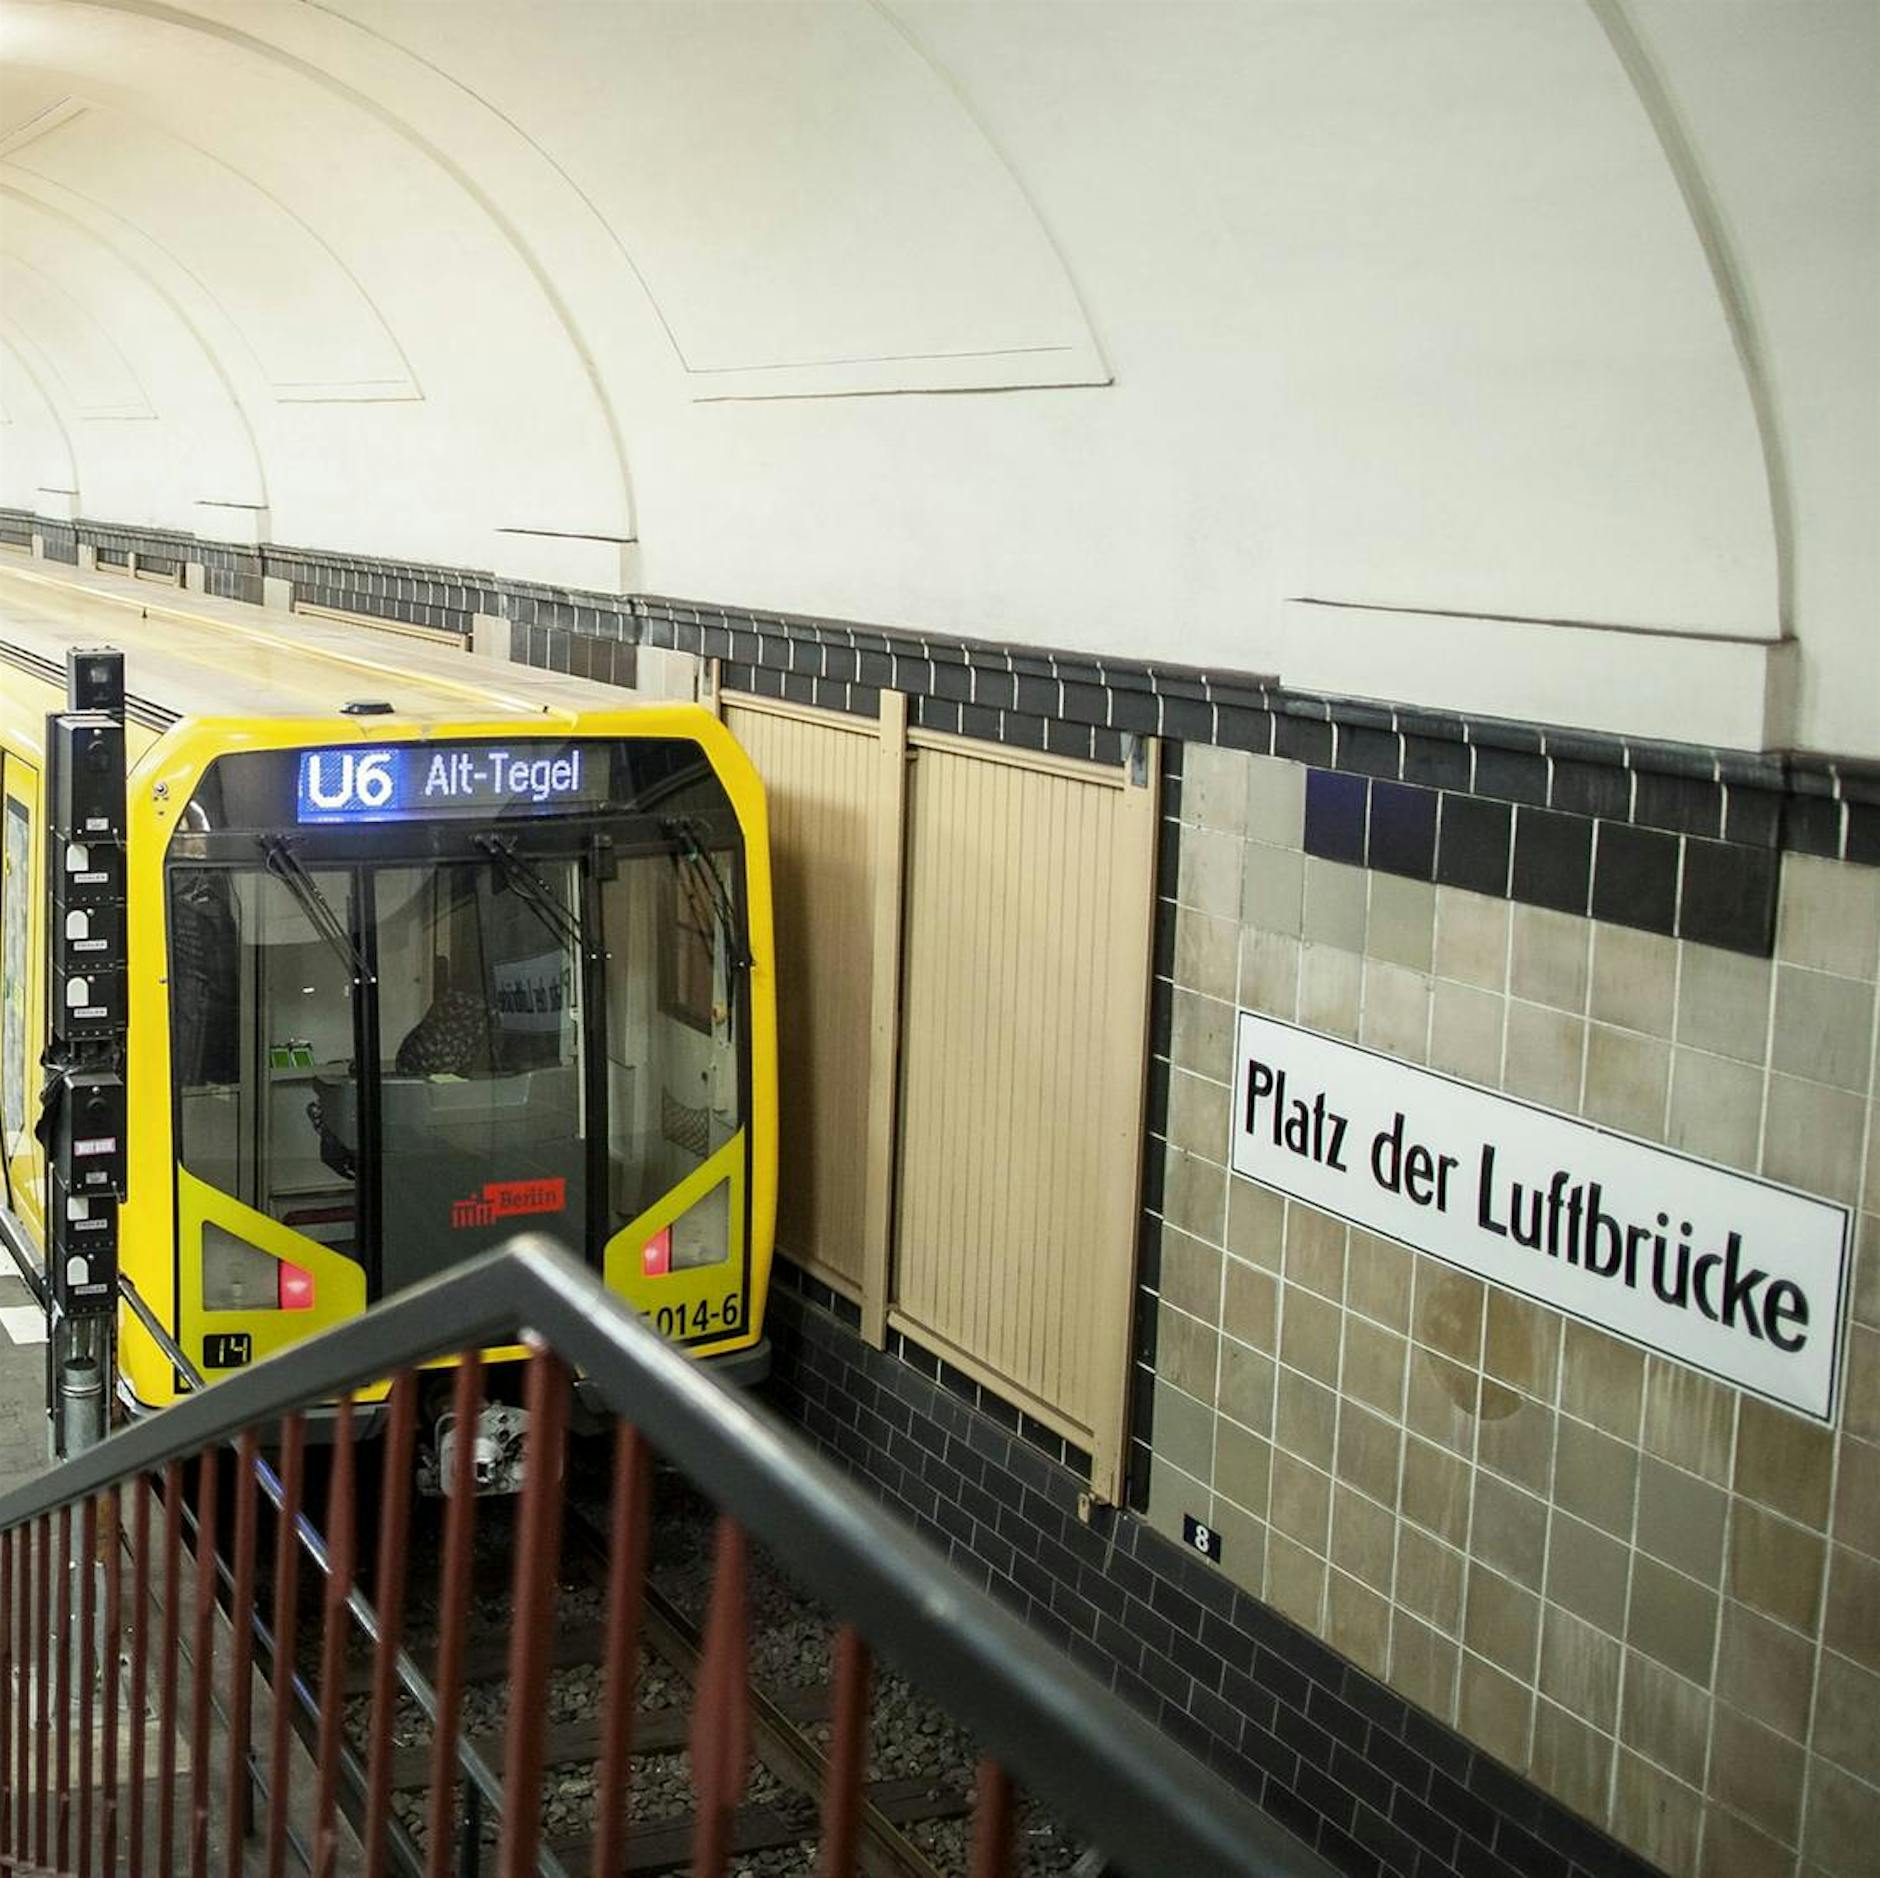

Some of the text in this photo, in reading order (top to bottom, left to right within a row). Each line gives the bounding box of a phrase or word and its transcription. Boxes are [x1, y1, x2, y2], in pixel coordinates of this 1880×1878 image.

[308, 750, 580, 808] U6 Alt-Tegel
[501, 1186, 557, 1207] Berlin
[1245, 1059, 1810, 1354] Platz der Luftbrücke
[637, 1293, 738, 1337] 014-6
[219, 1336, 248, 1365] 14
[1194, 1525, 1209, 1553] 8
